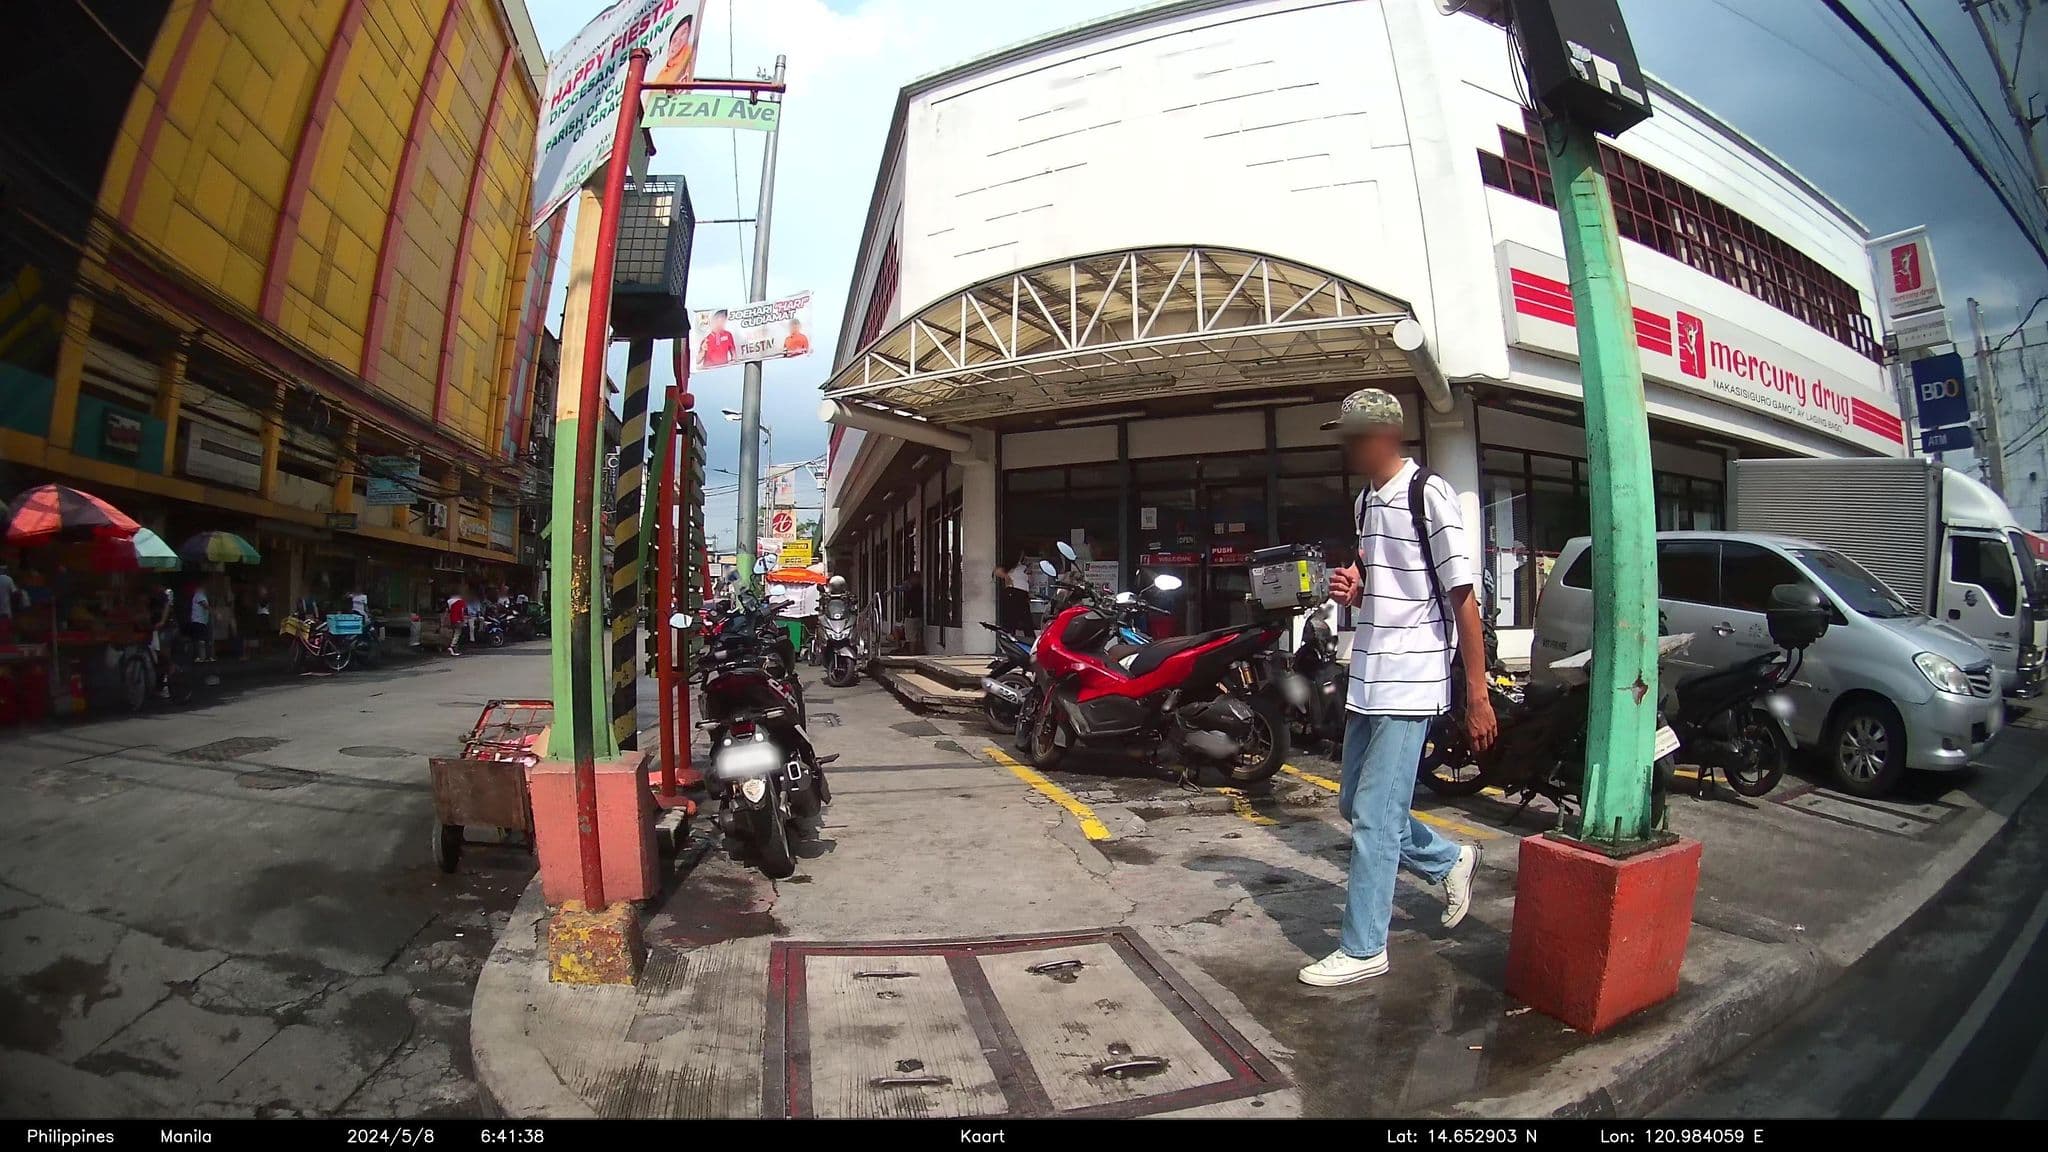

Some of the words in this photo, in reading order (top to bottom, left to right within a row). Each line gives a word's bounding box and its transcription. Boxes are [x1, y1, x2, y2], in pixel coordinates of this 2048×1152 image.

[551, 49, 606, 110] HAPPY
[595, 76, 616, 98] AND
[550, 61, 616, 125] DIOCESAN
[546, 114, 584, 154] PARISH
[587, 98, 602, 119] OF
[573, 125, 588, 143] OF
[728, 304, 773, 320] JOEHARI
[741, 310, 796, 328] CUDIAMAT
[1710, 341, 1807, 407] mercury
[1812, 379, 1850, 425] drug
[1713, 379, 1772, 406] NAKASISIGURO
[1921, 378, 1960, 402] BDO
[1928, 433, 1948, 447] ATM
